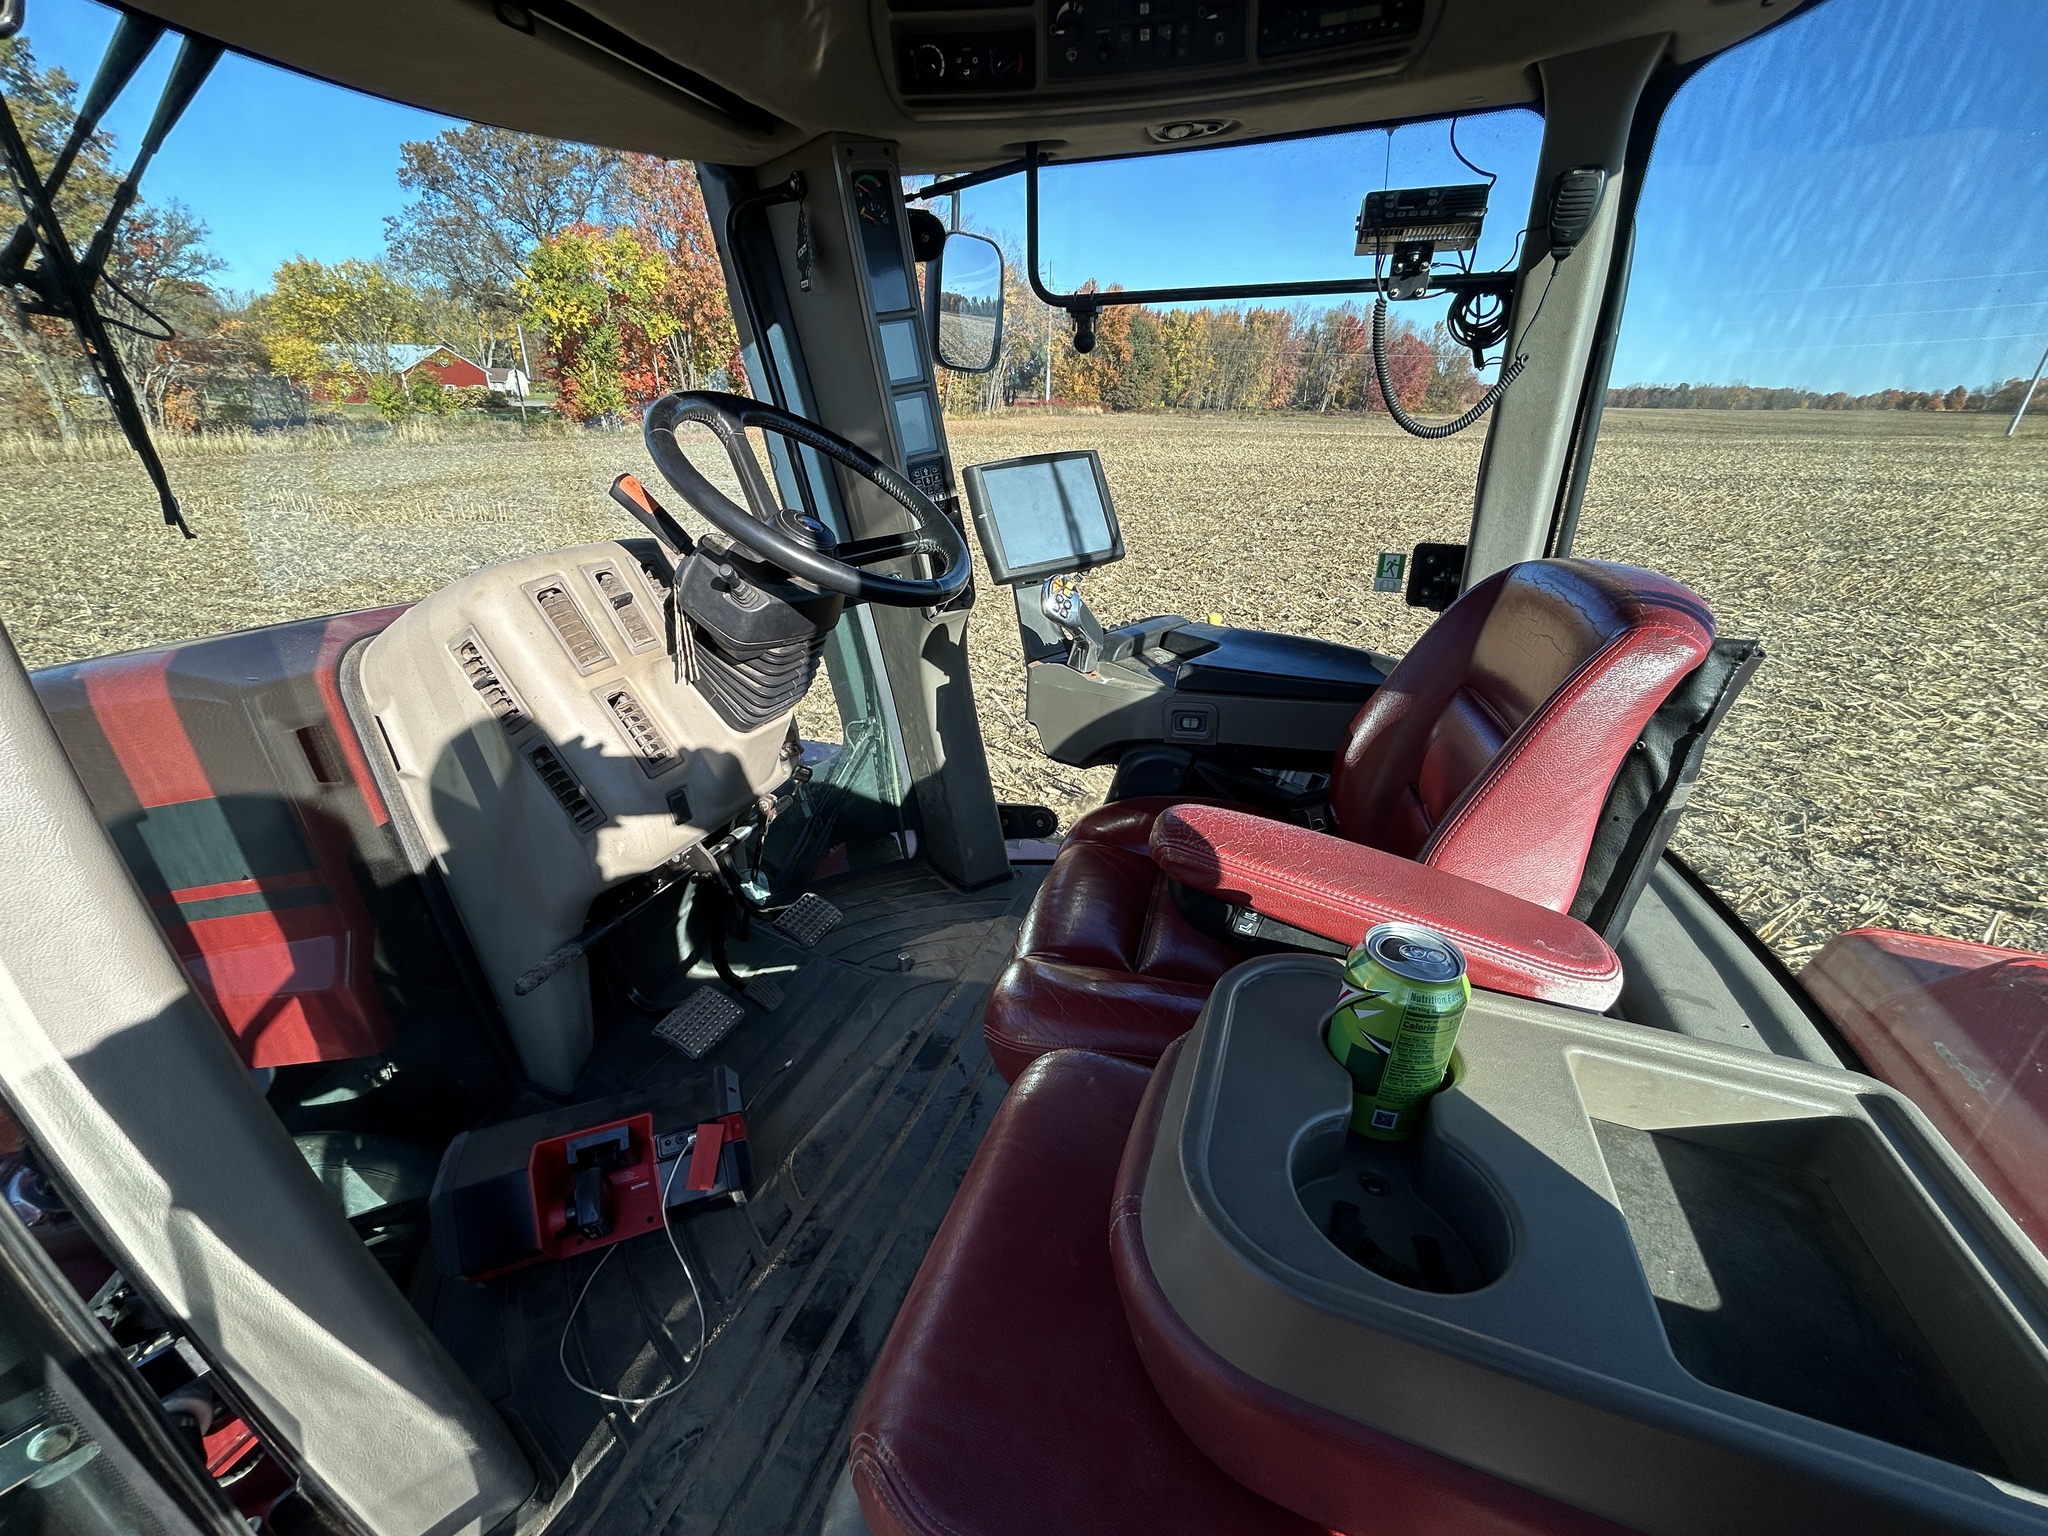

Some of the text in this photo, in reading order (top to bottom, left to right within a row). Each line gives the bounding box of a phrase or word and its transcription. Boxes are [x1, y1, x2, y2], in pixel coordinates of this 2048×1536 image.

[1410, 990, 1464, 1005] Nutrition Facts
[1408, 1004, 1430, 1014] Serving
[1402, 1020, 1439, 1031] Calories
